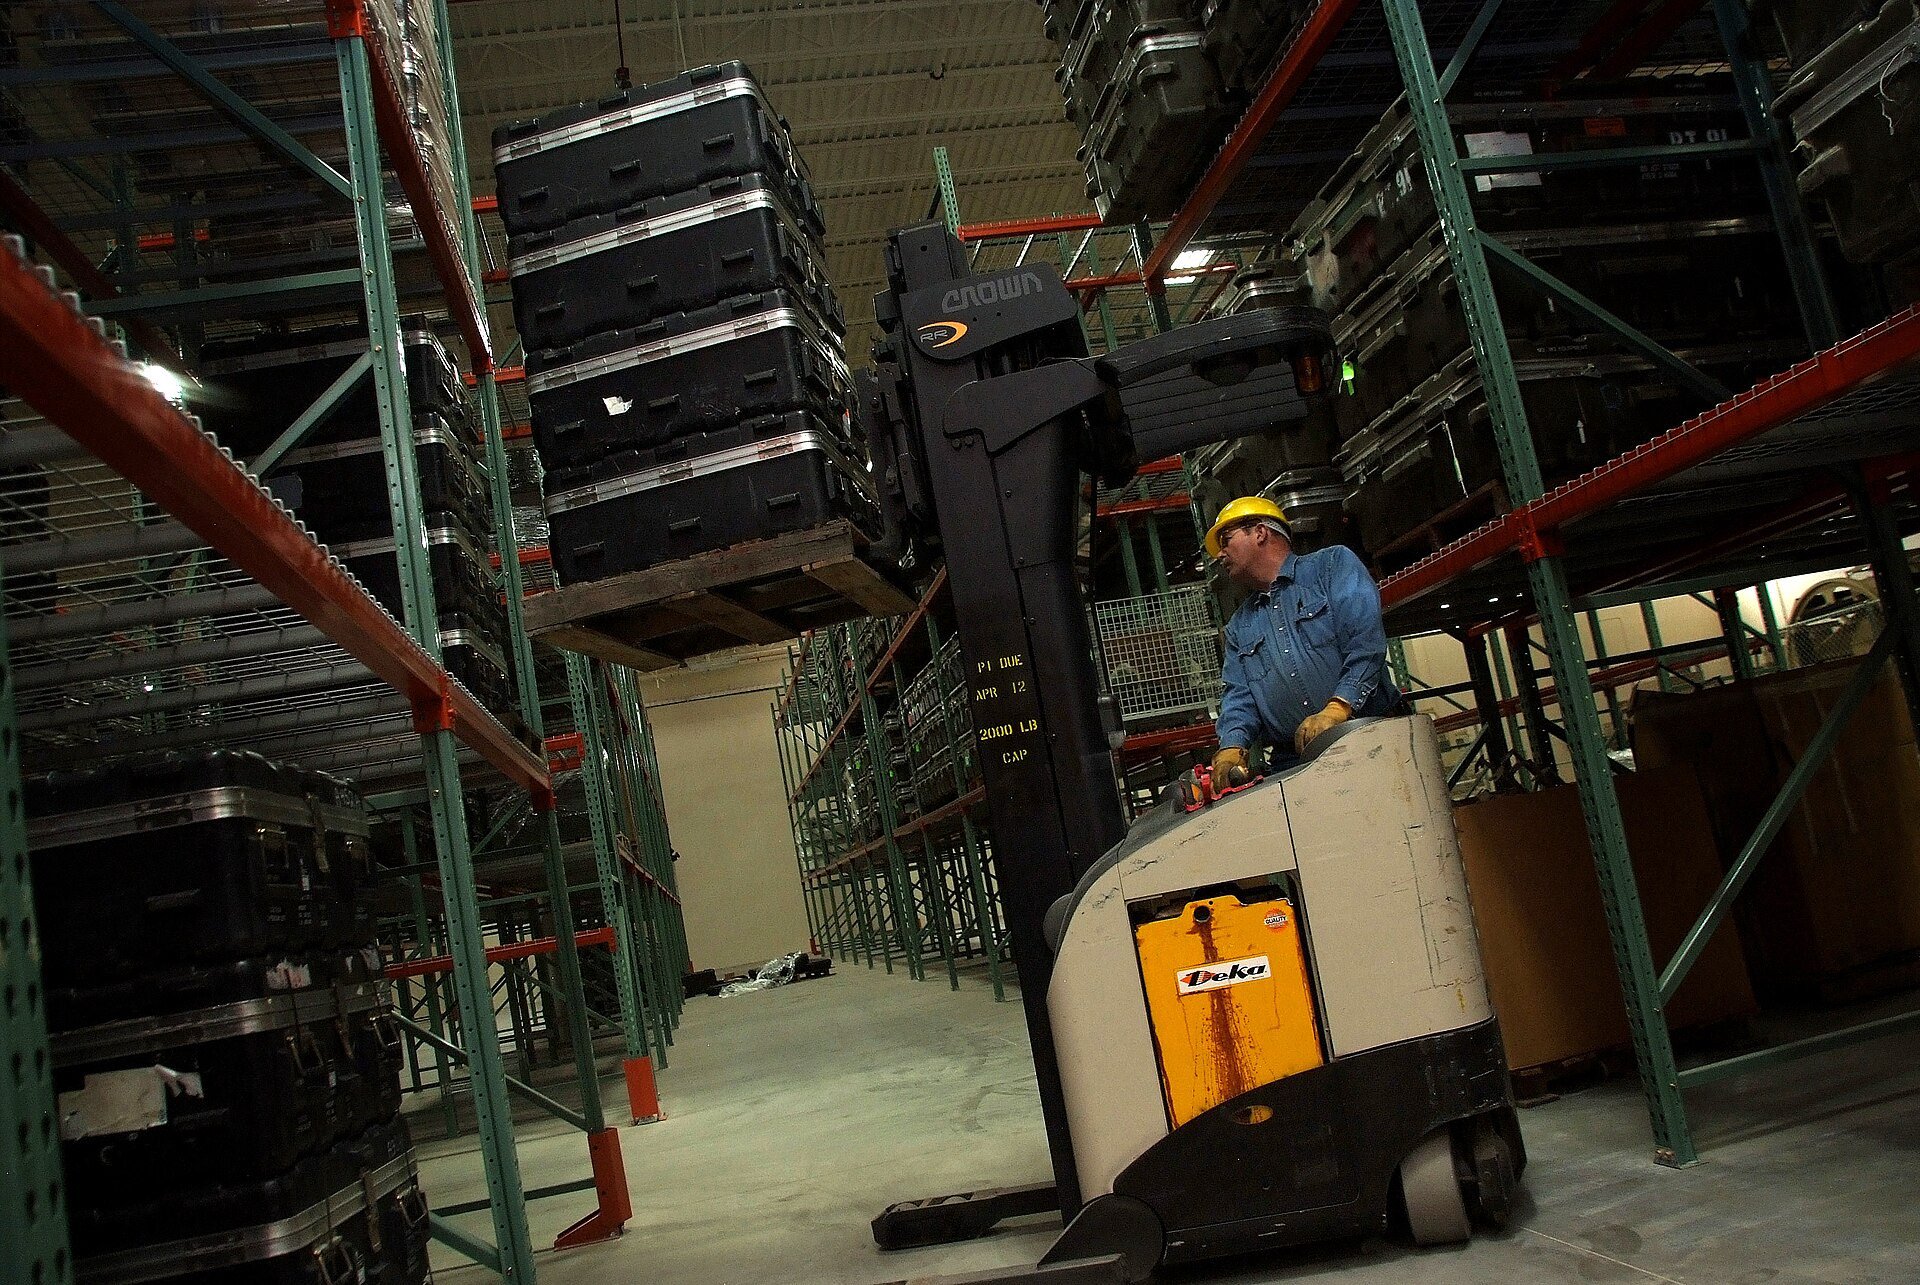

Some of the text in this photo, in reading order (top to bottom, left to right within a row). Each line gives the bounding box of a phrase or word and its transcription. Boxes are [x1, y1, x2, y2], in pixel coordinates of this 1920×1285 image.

[919, 329, 949, 343] RR
[999, 654, 1024, 669] DUE
[976, 680, 1027, 702] APR 12
[980, 719, 1038, 741] 2000 LB
[1002, 749, 1028, 764] CAP
[1187, 963, 1266, 987] Deka
